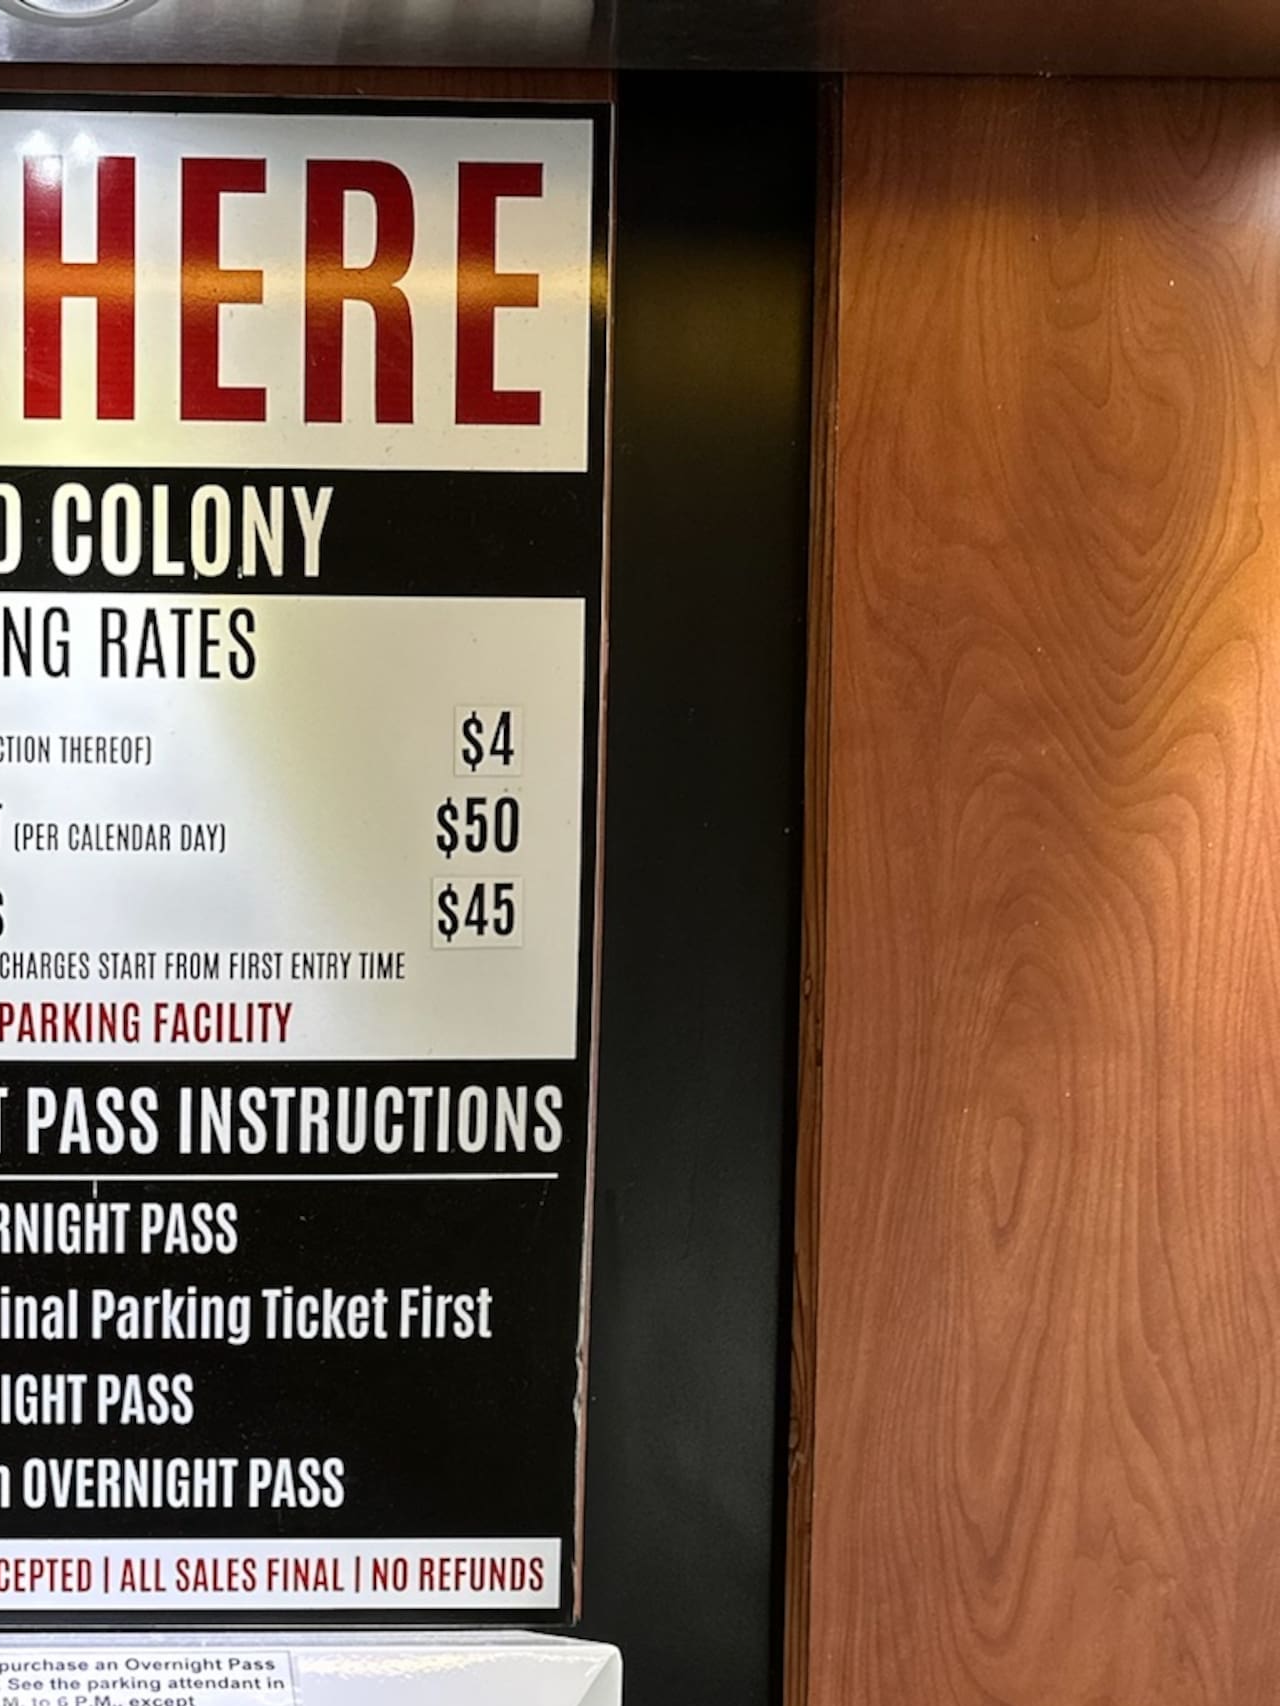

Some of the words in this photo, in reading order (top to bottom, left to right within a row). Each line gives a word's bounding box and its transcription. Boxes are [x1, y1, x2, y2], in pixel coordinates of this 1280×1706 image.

[22, 154, 544, 426] HERE
[52, 483, 333, 580] COLONY
[101, 608, 255, 680] RATES
[60, 736, 151, 765] THEREOF)
[462, 711, 514, 772] $4
[15, 823, 58, 852] (PER
[69, 824, 170, 851] CALENDAR
[181, 824, 225, 853] DAY)
[436, 796, 519, 860] $50
[438, 883, 514, 943] $45
[0, 952, 89, 979] CHARGES
[99, 952, 156, 979] START
[166, 952, 219, 980] FROM
[230, 952, 283, 980] FIRST
[292, 952, 352, 980] ENTRY
[359, 952, 405, 979] TIME
[154, 1002, 292, 1043] FACILITY
[28, 1087, 158, 1154] PASS
[180, 1086, 562, 1154] INSTRUCTIONS
[142, 1202, 237, 1254] PASS
[92, 1286, 250, 1345] Parking
[262, 1286, 388, 1339] Ticket
[400, 1285, 492, 1338] First
[24, 1458, 238, 1508] OVERNIGHT
[249, 1458, 344, 1508] PASS
[120, 1558, 166, 1592] ALL
[176, 1558, 256, 1592] SALES
[268, 1558, 344, 1592] FINAL
[372, 1558, 407, 1591] NO
[420, 1557, 544, 1591] REFUNDS
